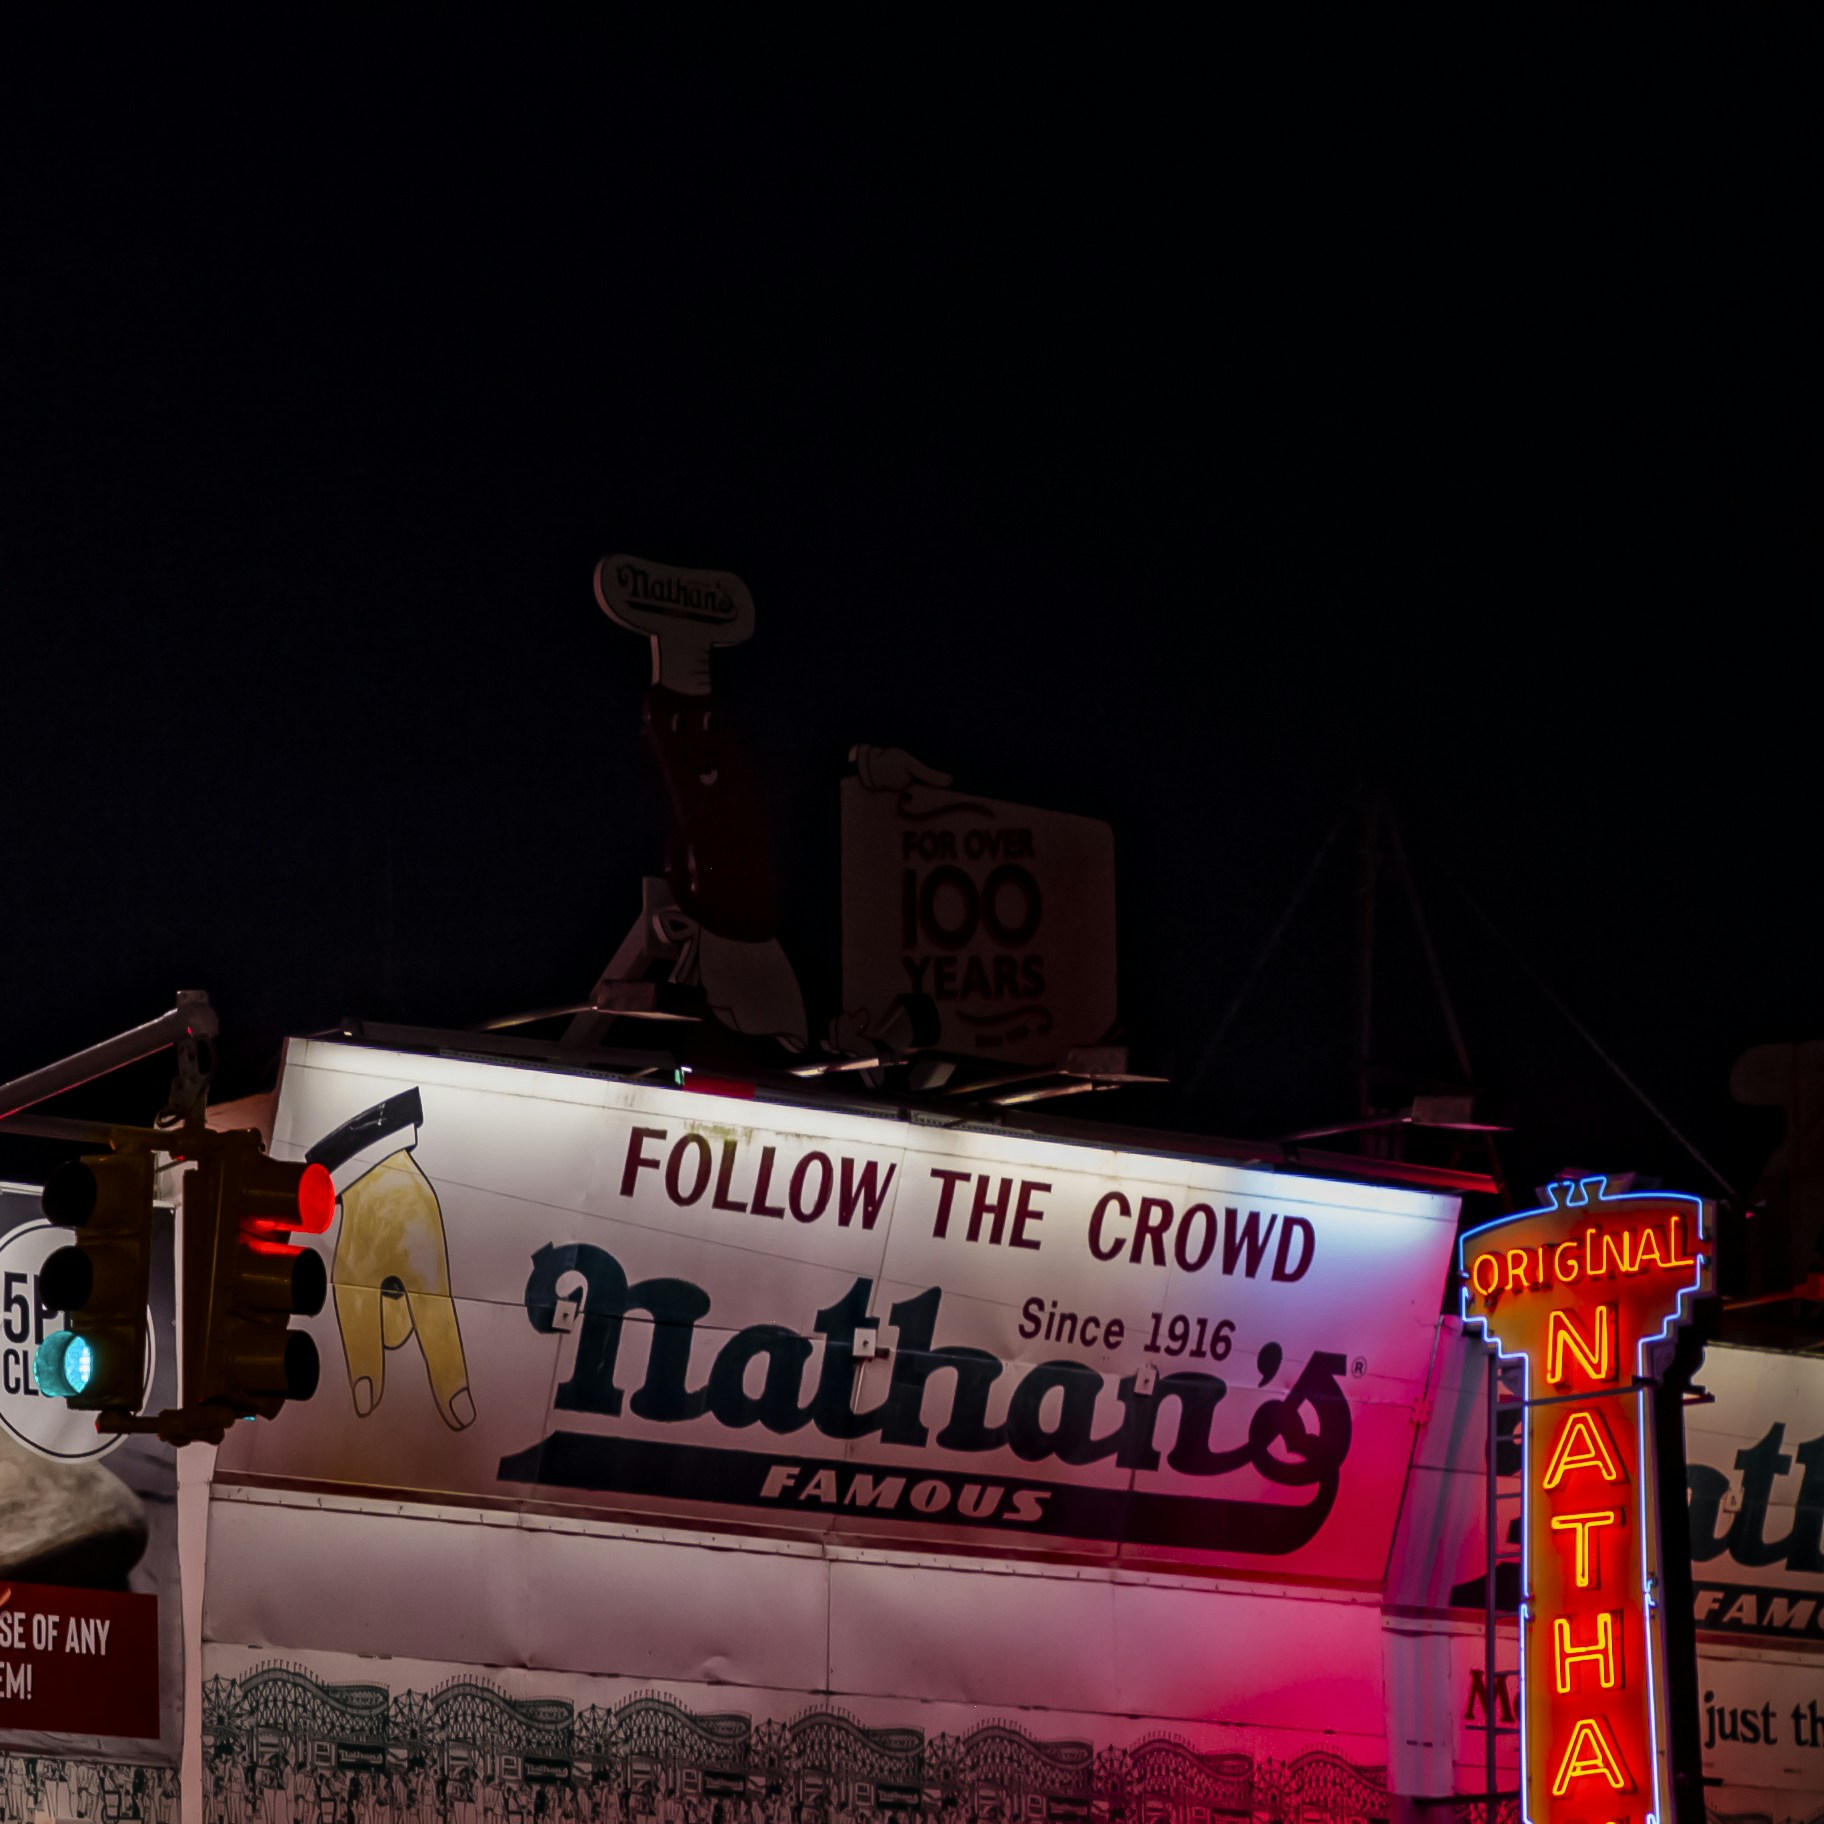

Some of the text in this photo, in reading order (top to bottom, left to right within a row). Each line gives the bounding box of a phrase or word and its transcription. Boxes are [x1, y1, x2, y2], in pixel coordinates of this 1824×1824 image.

[903, 829, 1035, 860] FOR OVER
[902, 864, 1042, 951] 100
[902, 955, 1046, 1000] YEARS
[619, 1126, 1317, 1284] FOLLOW THE CROWD
[1472, 1215, 1695, 1297] ORIGINAL
[1018, 1296, 1237, 1362] Since 1916
[524, 1242, 1352, 1488] Nathan's
[758, 1463, 1053, 1525] FAMOUS
[32, 1610, 60, 1651] OF
[66, 1613, 111, 1658] ANY
[1703, 1690, 1777, 1749] just
